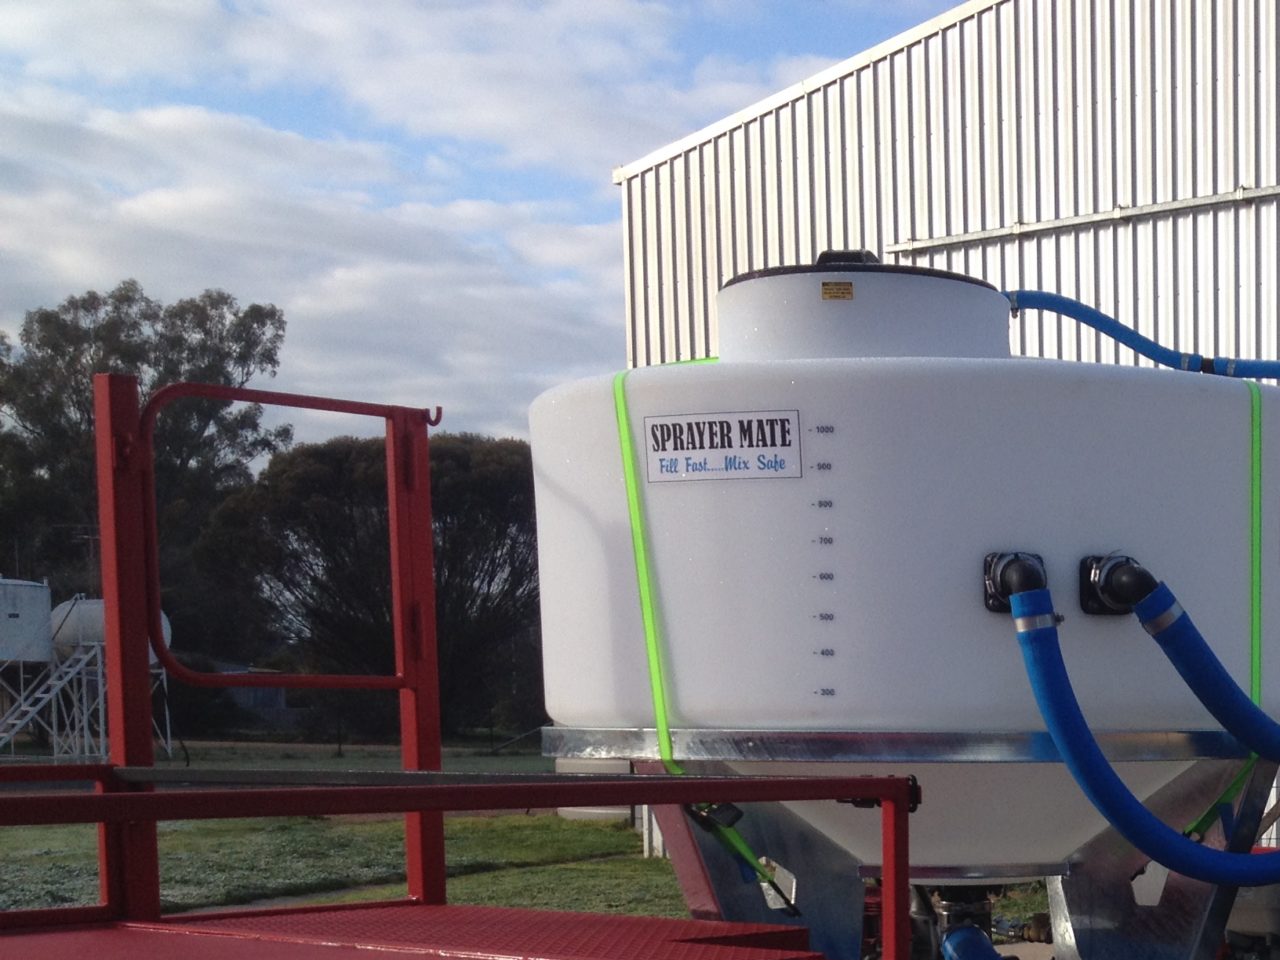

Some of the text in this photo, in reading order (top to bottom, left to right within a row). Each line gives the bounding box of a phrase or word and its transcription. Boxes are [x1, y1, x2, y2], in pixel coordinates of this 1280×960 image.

[816, 425, 834, 434] 1000
[651, 418, 792, 452] SPRAYER MATE
[659, 458, 679, 474] Fill
[757, 454, 786, 473] Safe
[817, 462, 832, 470] 900
[819, 536, 833, 545] 700
[819, 613, 834, 621] 500
[820, 648, 835, 656] 400
[820, 688, 835, 696] 300
